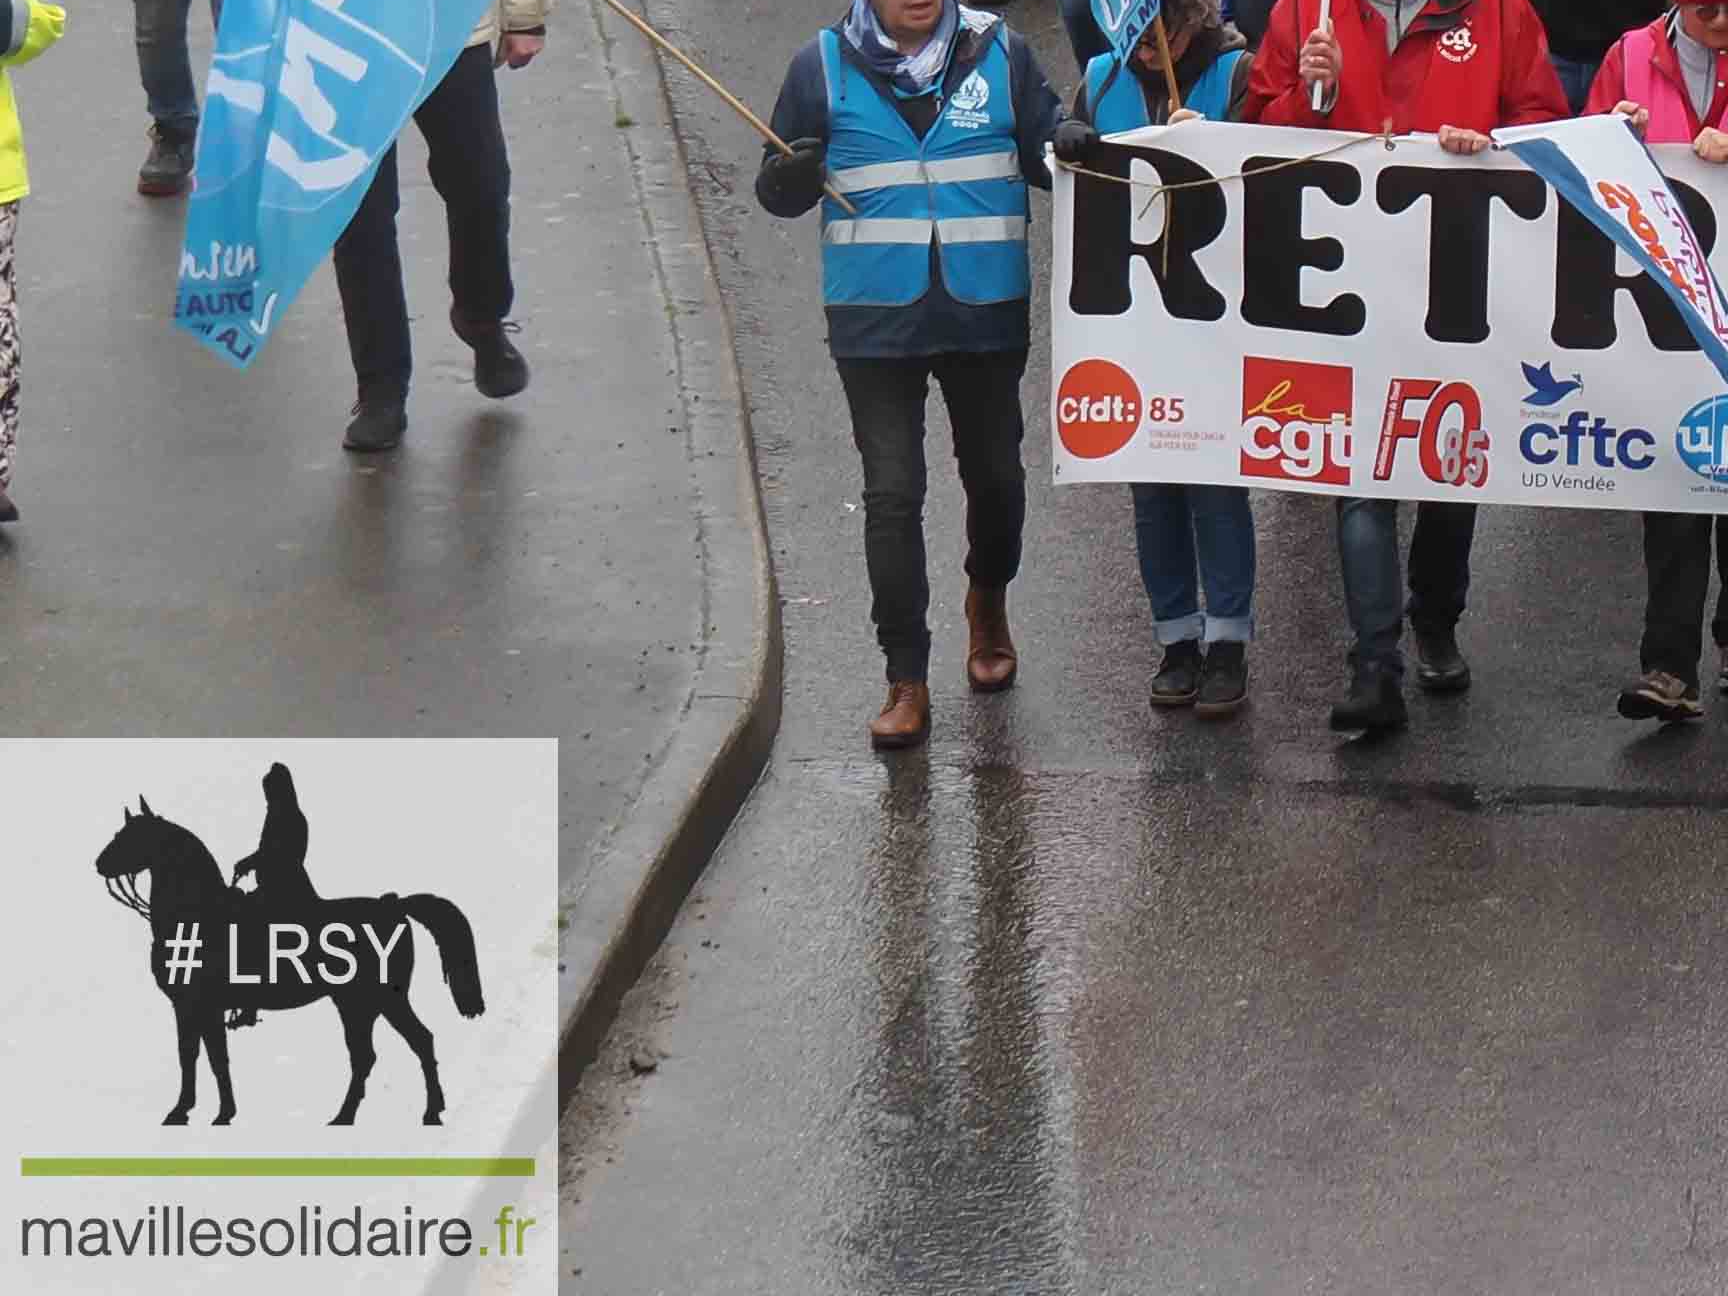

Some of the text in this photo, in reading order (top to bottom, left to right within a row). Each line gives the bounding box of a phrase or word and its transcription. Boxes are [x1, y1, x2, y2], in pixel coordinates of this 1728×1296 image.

[1059, 395, 1136, 424] Cfdt:
[1149, 396, 1185, 423] 85
[1373, 377, 1483, 485] FO
[1240, 412, 1354, 477] cgt
[1440, 428, 1490, 487] 85
[1518, 410, 1657, 470] cftc
[1521, 472, 1616, 492] UD Vendée
